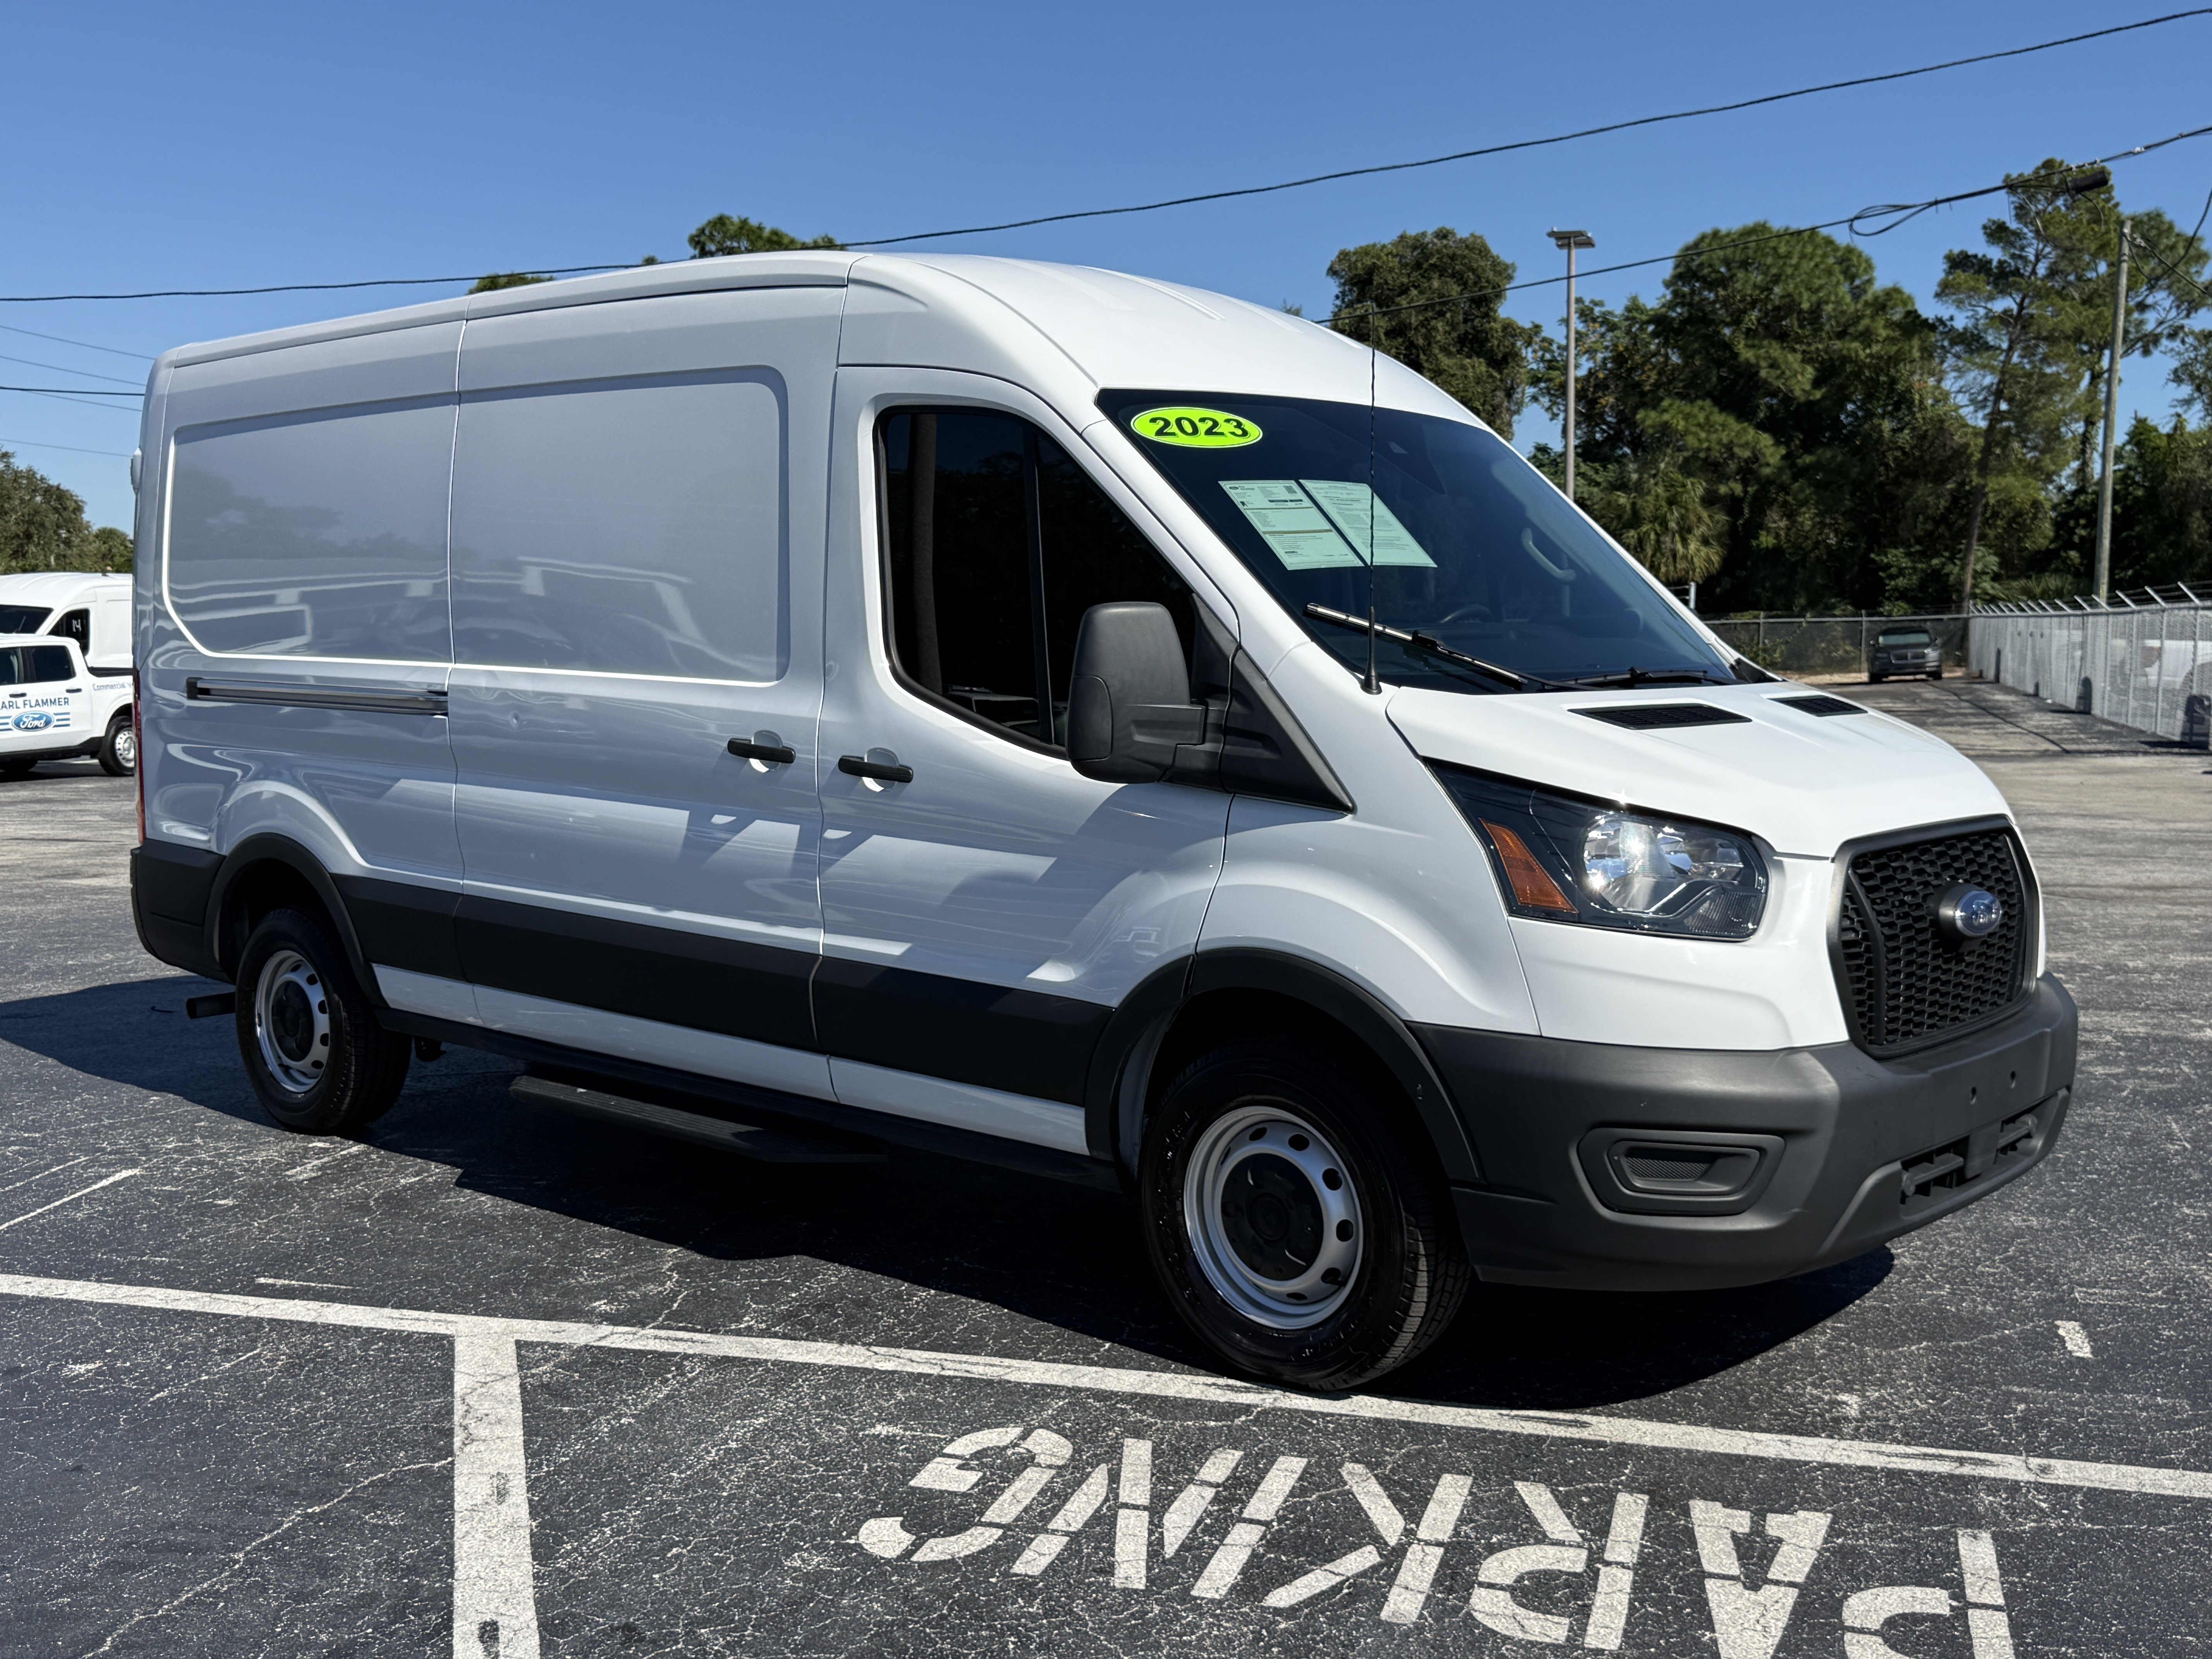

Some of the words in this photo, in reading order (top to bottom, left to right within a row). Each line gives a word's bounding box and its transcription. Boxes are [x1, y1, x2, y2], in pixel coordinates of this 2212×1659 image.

[1149, 417, 1251, 439] 2023
[0, 700, 20, 710] ARL
[23, 697, 69, 708] FLAMMER
[20, 714, 46, 728] Ford
[858, 1427, 2016, 1659] PARKING
